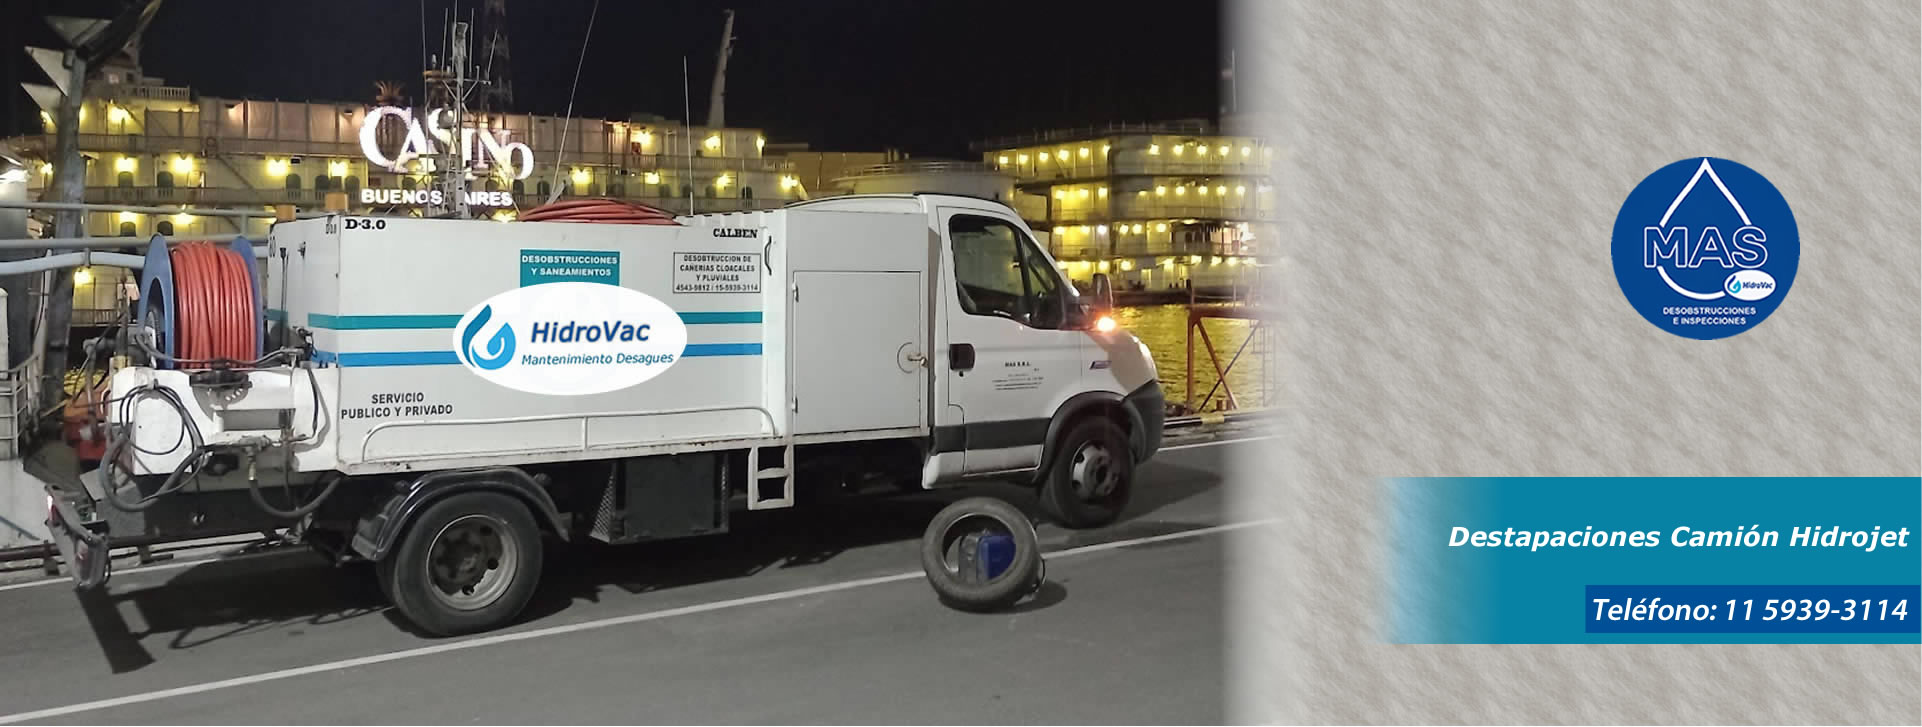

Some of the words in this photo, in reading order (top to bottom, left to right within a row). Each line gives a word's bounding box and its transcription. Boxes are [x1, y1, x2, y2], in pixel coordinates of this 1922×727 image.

[359, 105, 535, 181] CASINO
[361, 188, 443, 205] BUENOS
[463, 190, 513, 206] AIRES
[713, 228, 758, 239] CALBEN
[521, 255, 618, 264] DESOBSTRUCCIONES
[531, 267, 538, 276] Y
[540, 267, 612, 277] SANEAMIENTOS
[716, 264, 755, 272] CLOACALES
[702, 274, 740, 282] PLUVIALES
[371, 392, 425, 404] SERVICIO
[341, 407, 391, 419] PUBLICO
[394, 406, 402, 417] Y
[405, 404, 453, 416] PRIVADO
